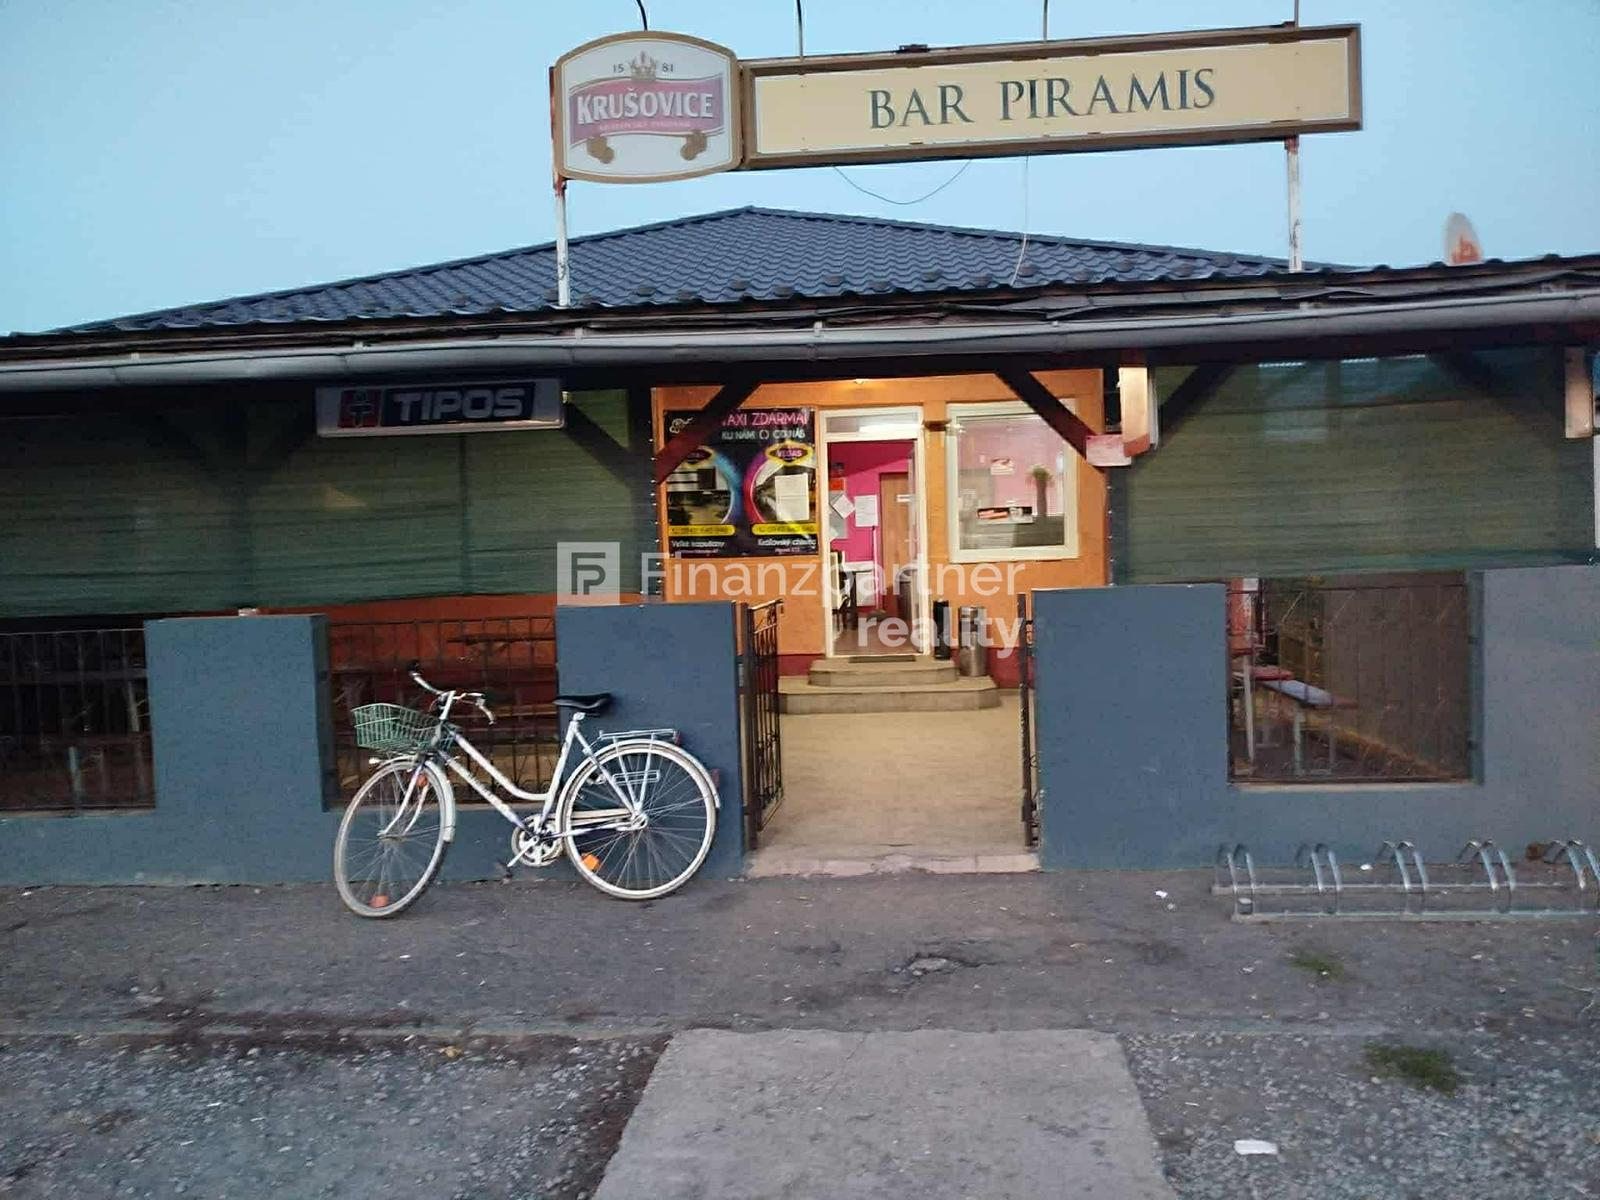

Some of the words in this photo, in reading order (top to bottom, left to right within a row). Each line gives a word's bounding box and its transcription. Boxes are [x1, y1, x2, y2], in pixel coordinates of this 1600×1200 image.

[612, 63, 625, 74] 15
[661, 62, 674, 73] 81
[577, 87, 714, 125] KRUŠOVICE
[867, 84, 975, 129] BAR
[996, 68, 1216, 122] PIRAMIS
[392, 387, 526, 422] TIPOS
